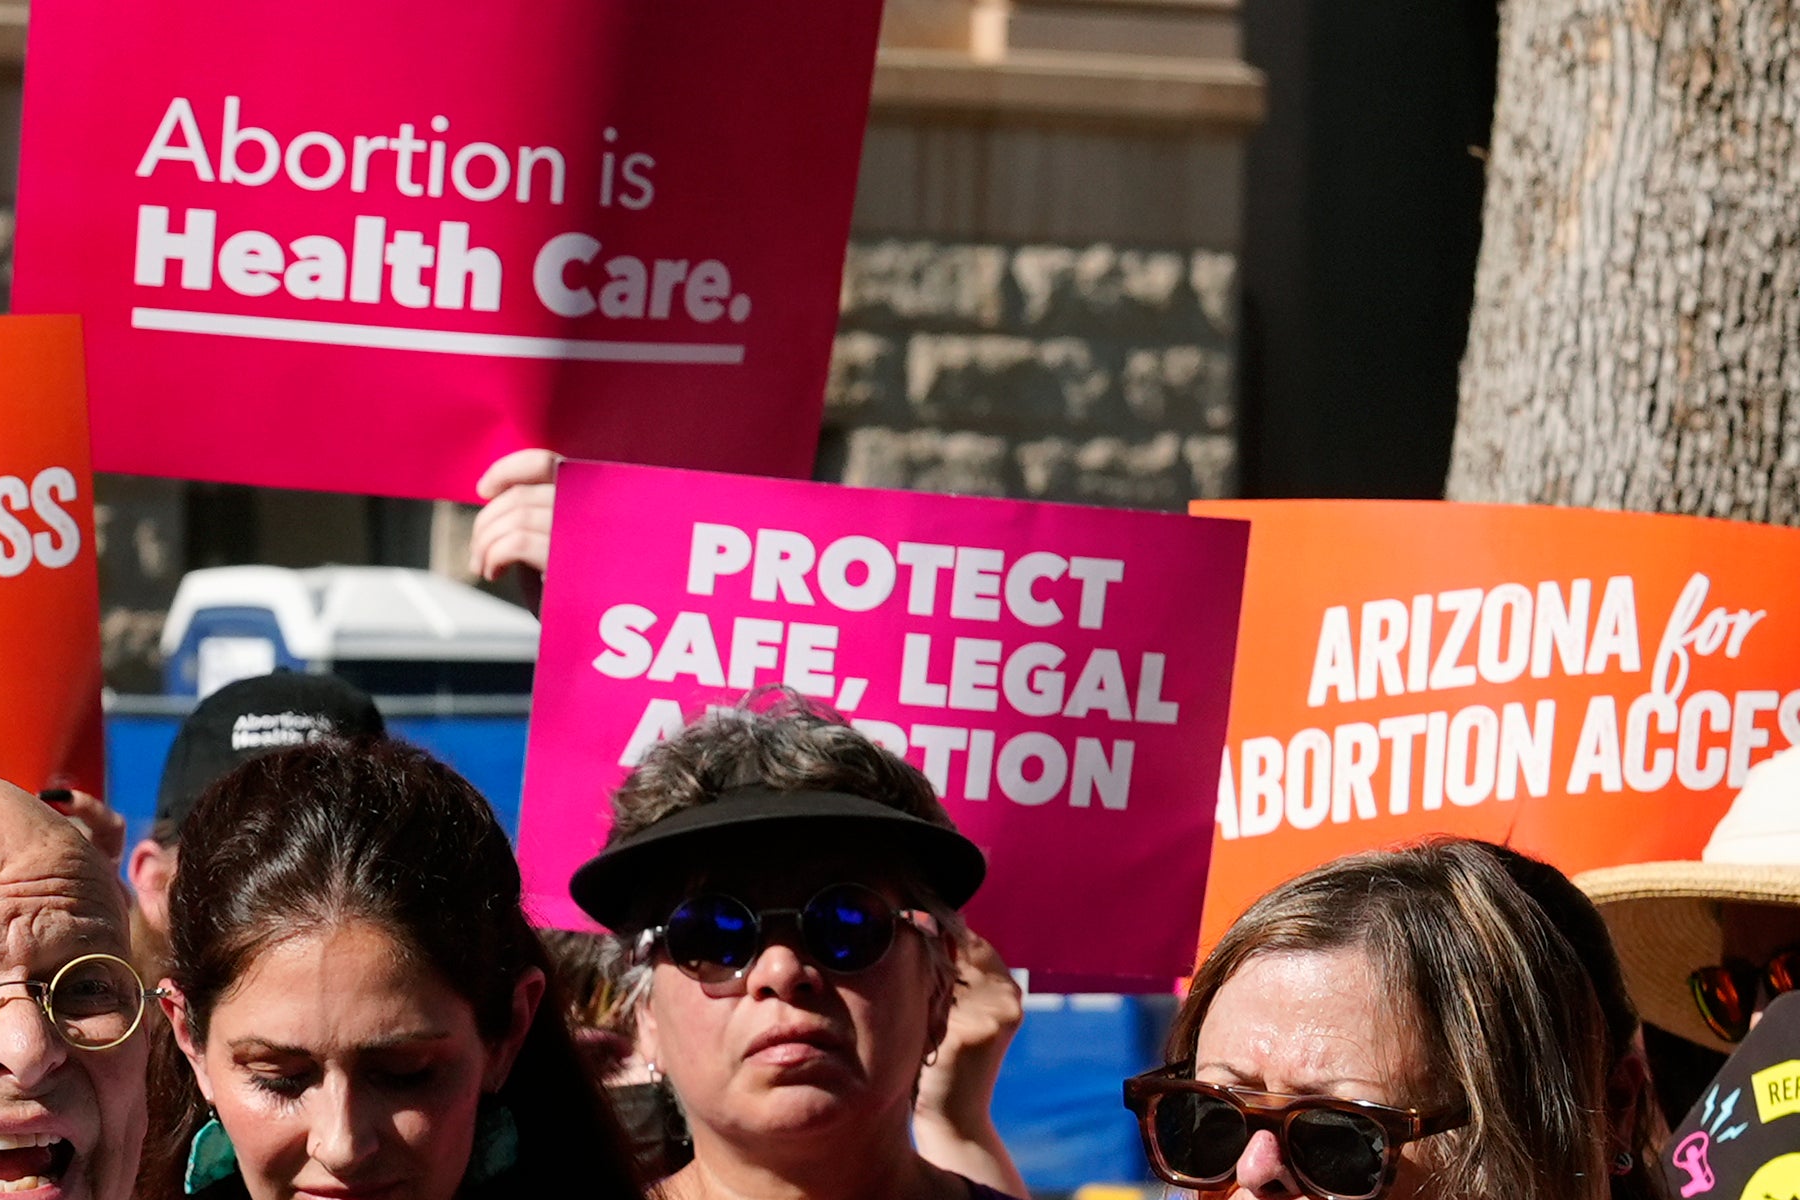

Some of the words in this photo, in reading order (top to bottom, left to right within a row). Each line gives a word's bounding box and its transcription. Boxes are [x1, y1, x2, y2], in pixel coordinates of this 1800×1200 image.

[135, 96, 566, 206] Abortion
[600, 127, 657, 212] is
[133, 204, 503, 313] Health
[533, 231, 752, 325] Care.
[686, 521, 1125, 630] PROTECT
[591, 603, 869, 712] SAFE,
[899, 632, 1179, 725] LEGAL
[1308, 575, 1642, 707] ARIZONA
[1649, 571, 1767, 704] for
[1214, 698, 1556, 841] ABORTION
